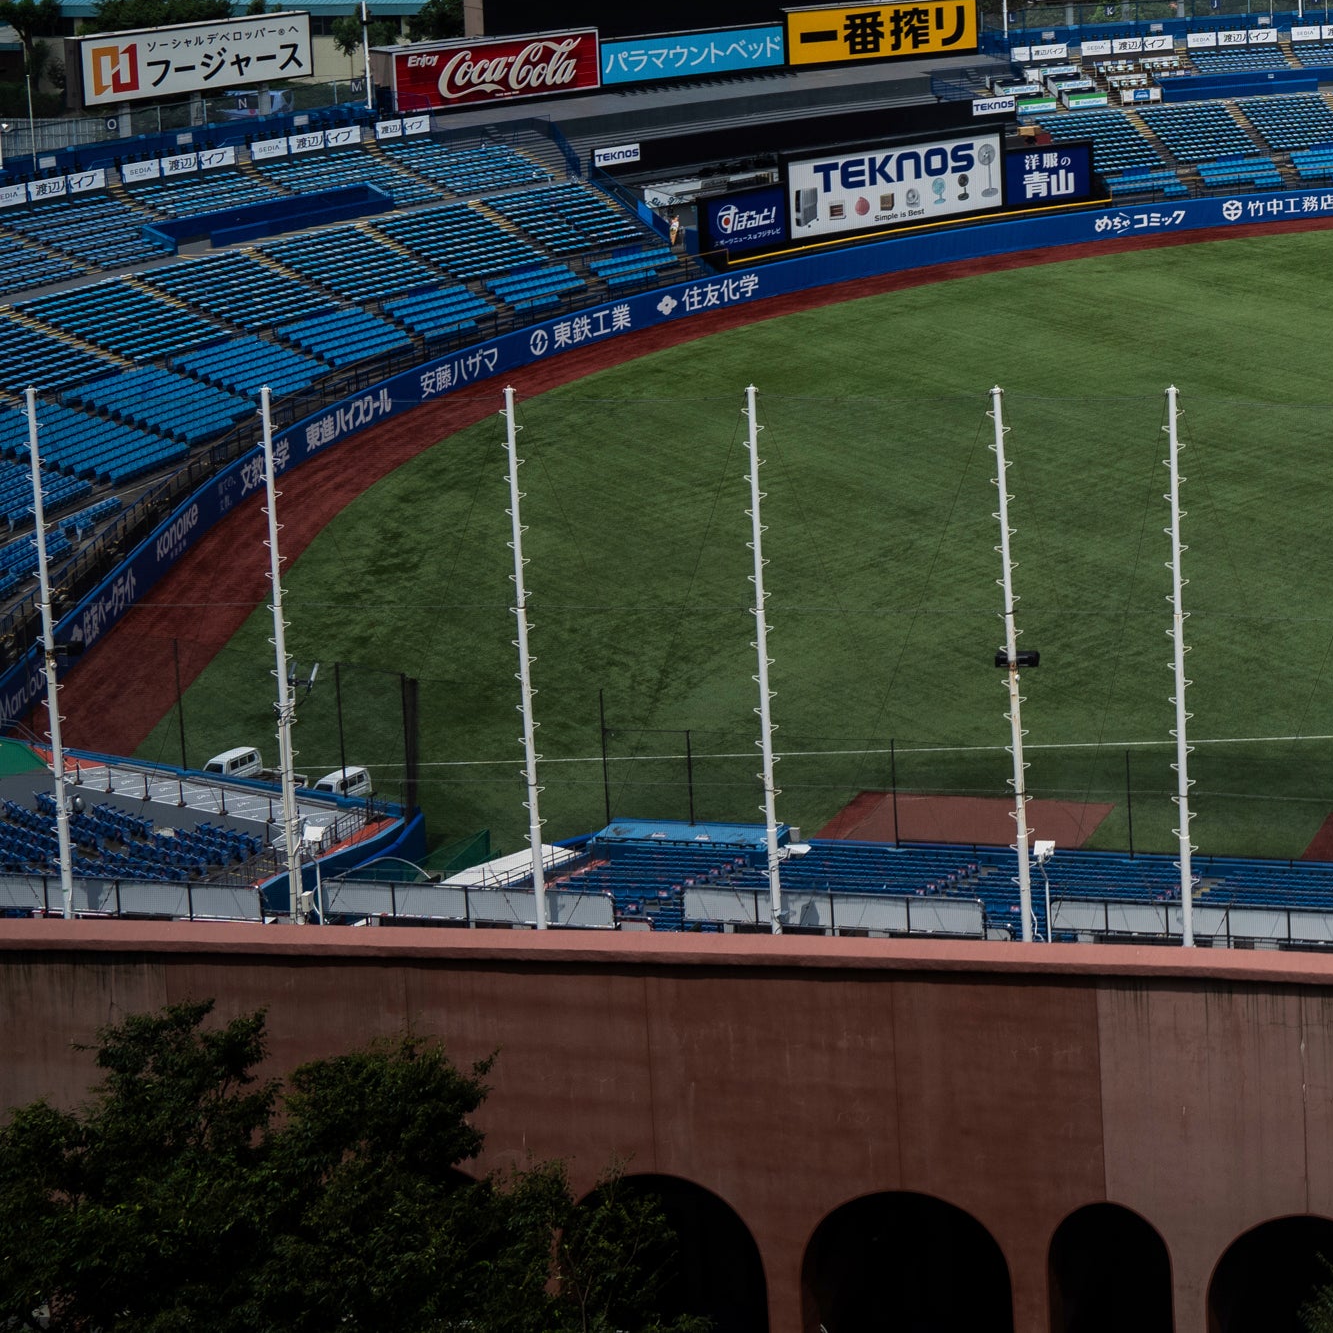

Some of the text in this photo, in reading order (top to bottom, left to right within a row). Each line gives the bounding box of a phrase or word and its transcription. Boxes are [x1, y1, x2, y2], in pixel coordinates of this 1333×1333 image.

[1107, 6, 1114, 15] K
[800, 4, 965, 55] 一番搾り
[147, 43, 303, 87] フージャース
[407, 54, 439, 67] Enjoy
[437, 36, 582, 98] Coca-Cola
[605, 36, 781, 75] パラマウントベッド
[352, 81, 361, 92] M
[238, 98, 247, 109] N
[973, 98, 1015, 112] TEKNOS
[596, 147, 639, 163] TEKNOS
[813, 142, 975, 193] TEKNOS
[1024, 153, 1071, 170] 洋服の
[129, 166, 152, 176] SEDIA
[1023, 169, 1075, 199] 青山
[874, 213, 899, 222] Simple
[906, 208, 925, 217] Best
[1095, 210, 1186, 233] めちゃコミック
[681, 274, 759, 312] 住友化学
[553, 304, 631, 350] 東鉄工業
[420, 347, 498, 399] 安藤ハザマ
[305, 387, 392, 453] 東進ハイスクール
[241, 437, 290, 496] 文教学
